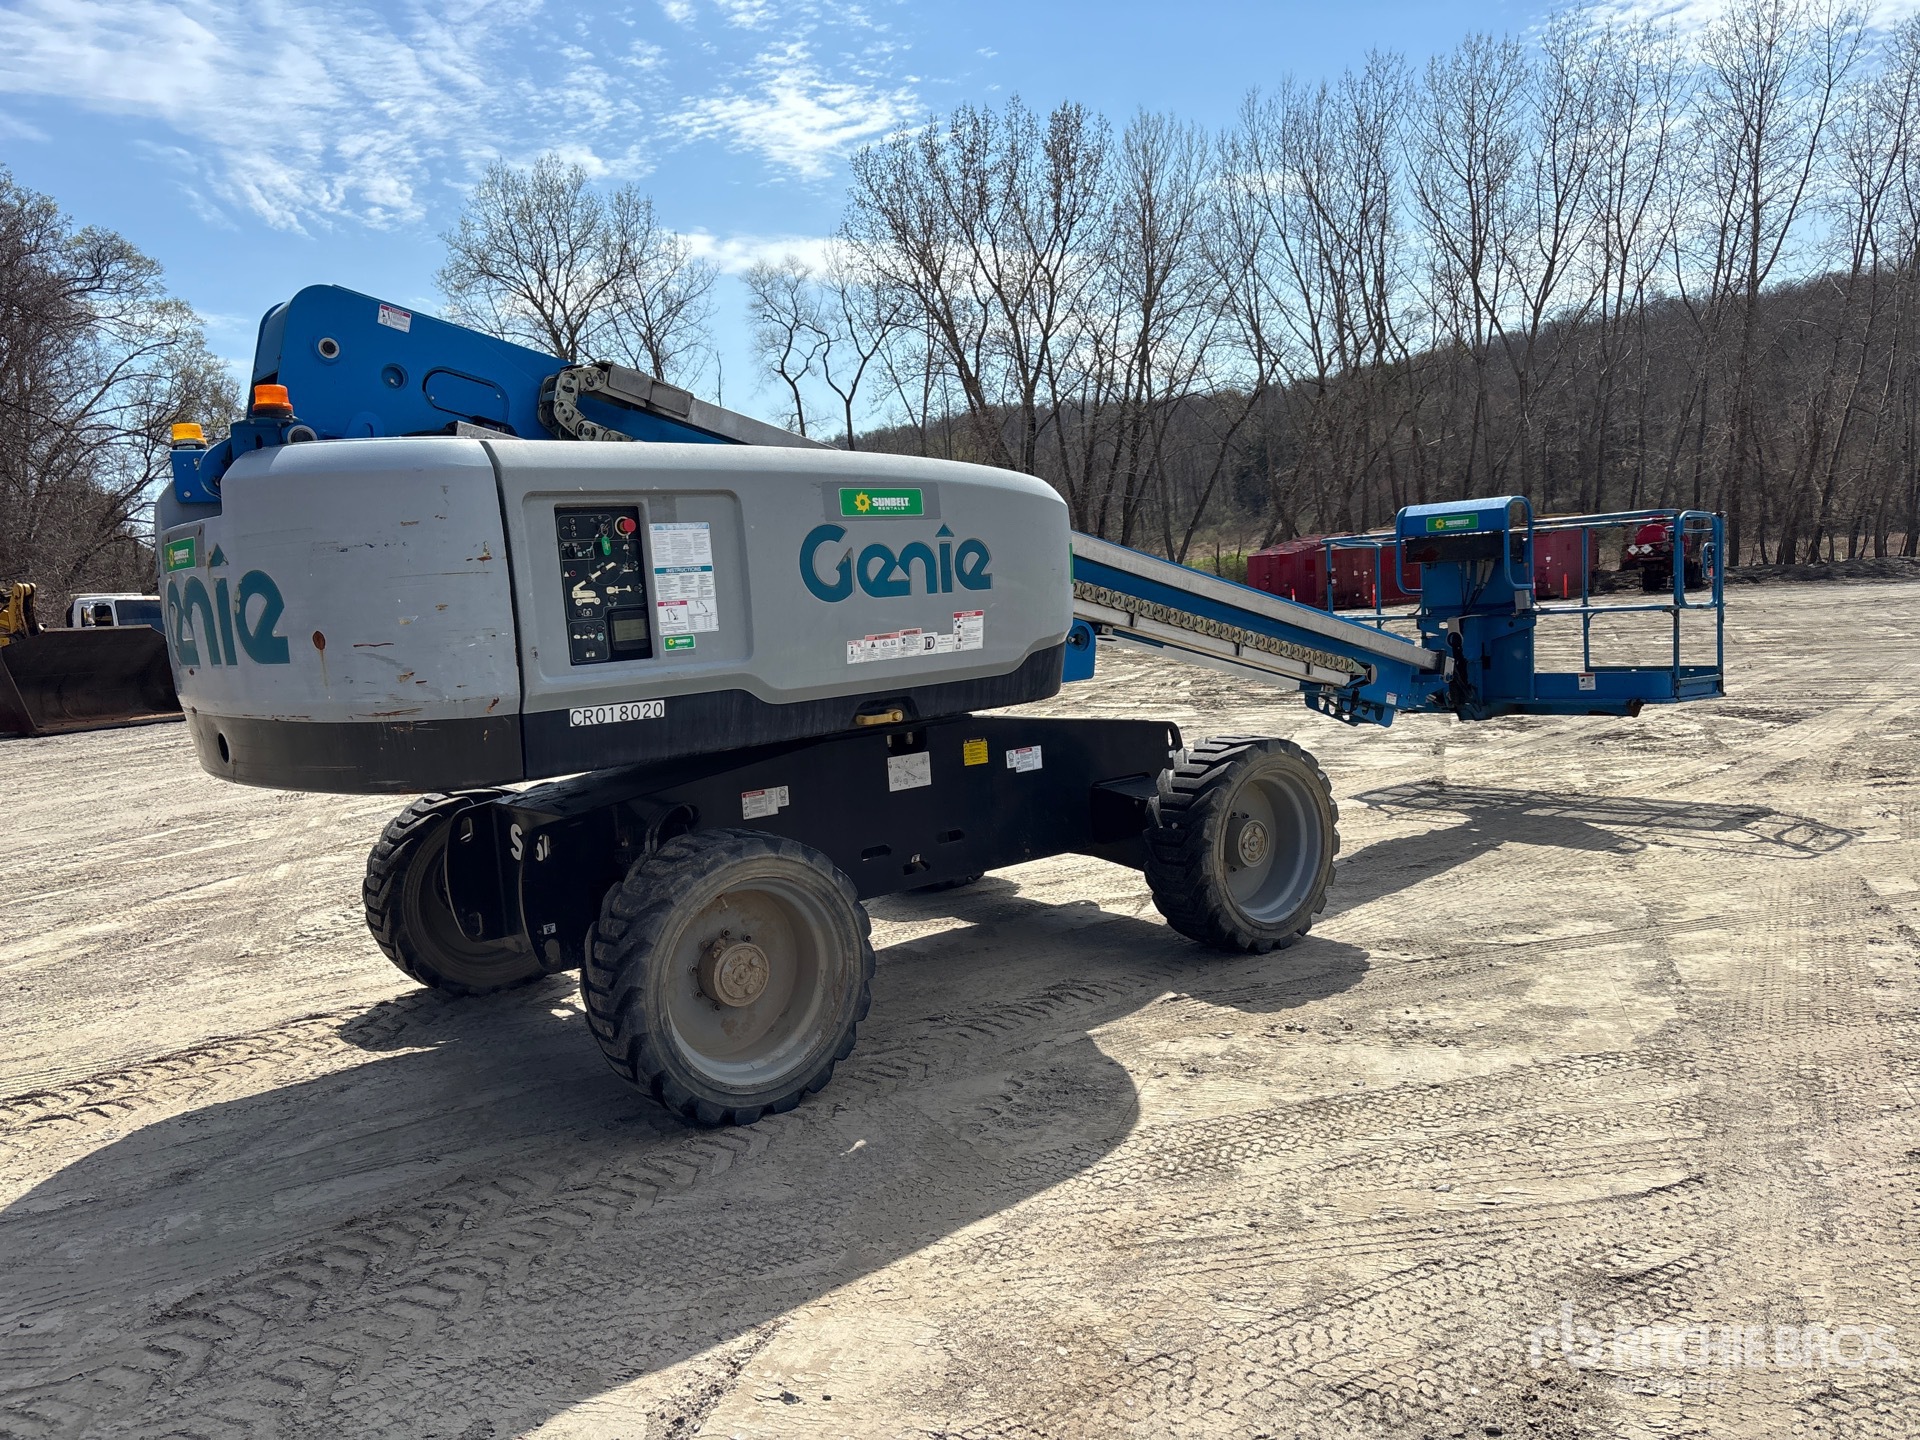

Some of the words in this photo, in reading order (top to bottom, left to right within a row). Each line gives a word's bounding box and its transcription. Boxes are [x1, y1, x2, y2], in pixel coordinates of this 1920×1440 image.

[872, 497, 910, 507] SUNBELT
[799, 524, 992, 603] Genie
[166, 543, 290, 666] enie
[571, 702, 663, 726] CR018020
